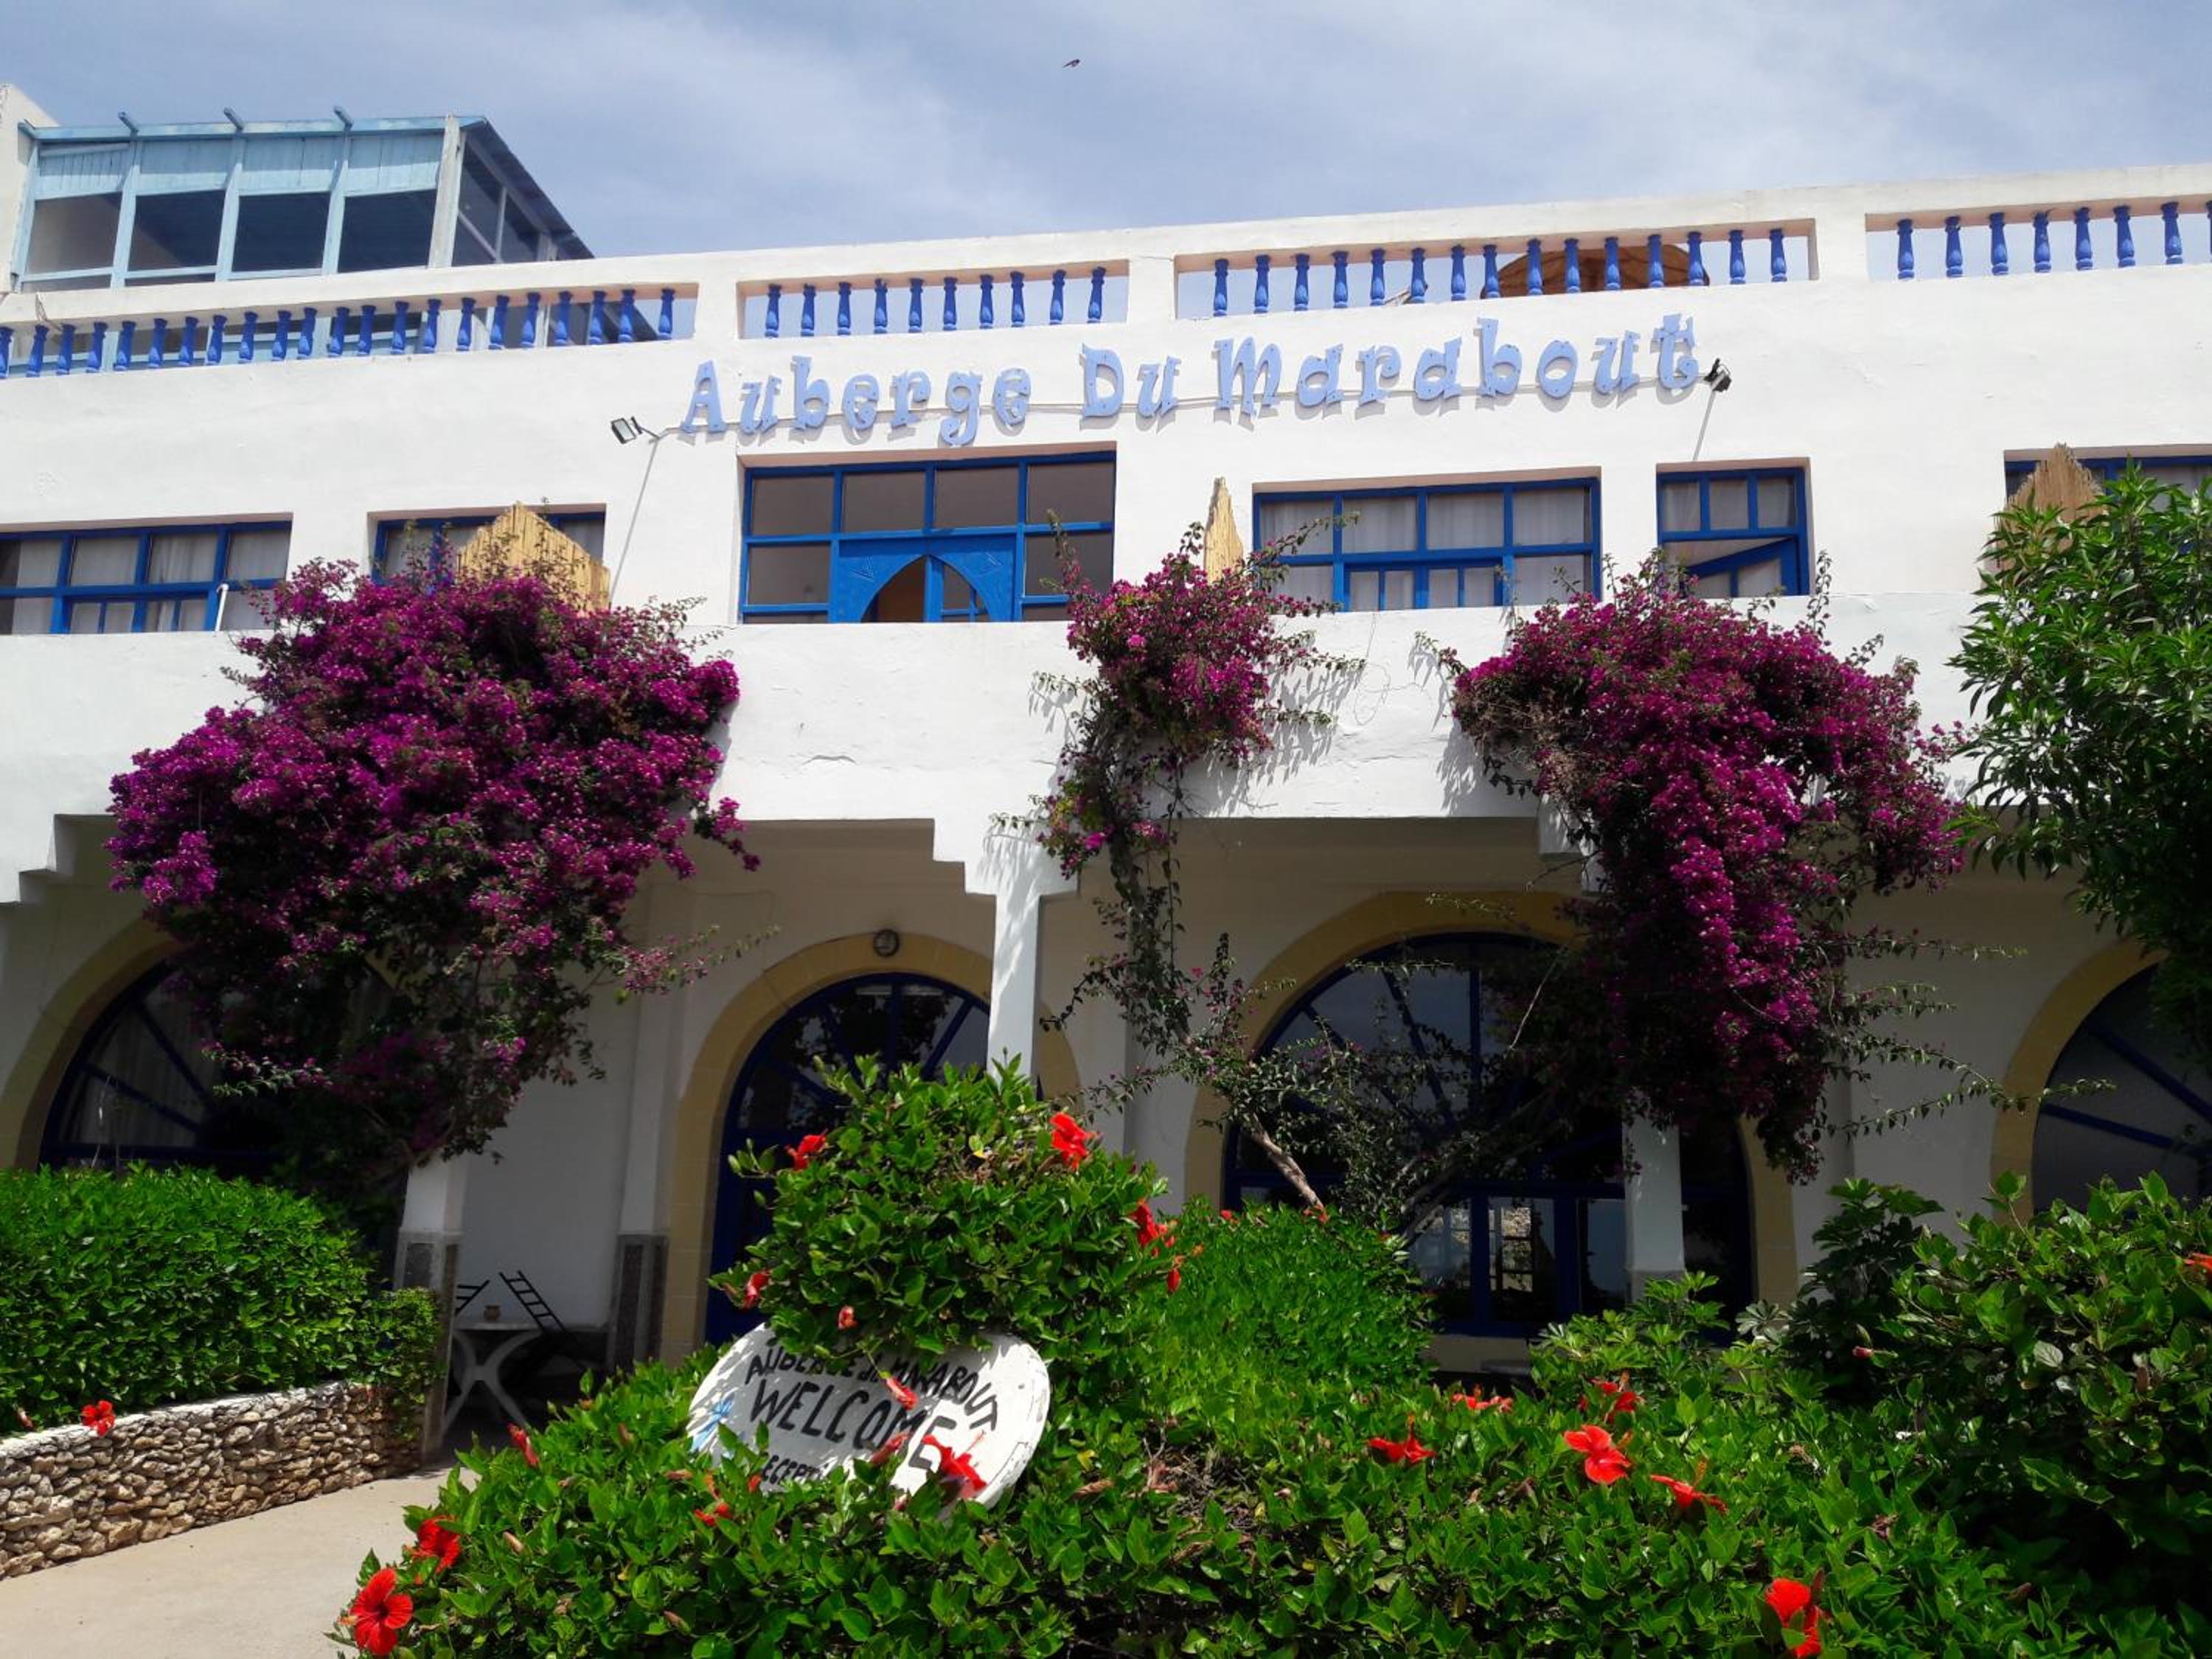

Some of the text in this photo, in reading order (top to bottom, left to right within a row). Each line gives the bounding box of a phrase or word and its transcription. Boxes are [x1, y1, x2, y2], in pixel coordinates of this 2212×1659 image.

[680, 313, 1699, 445] Auberge Du Marabout
[751, 1379, 957, 1470] WELCOME
[891, 1358, 998, 1431] MAABOUT
